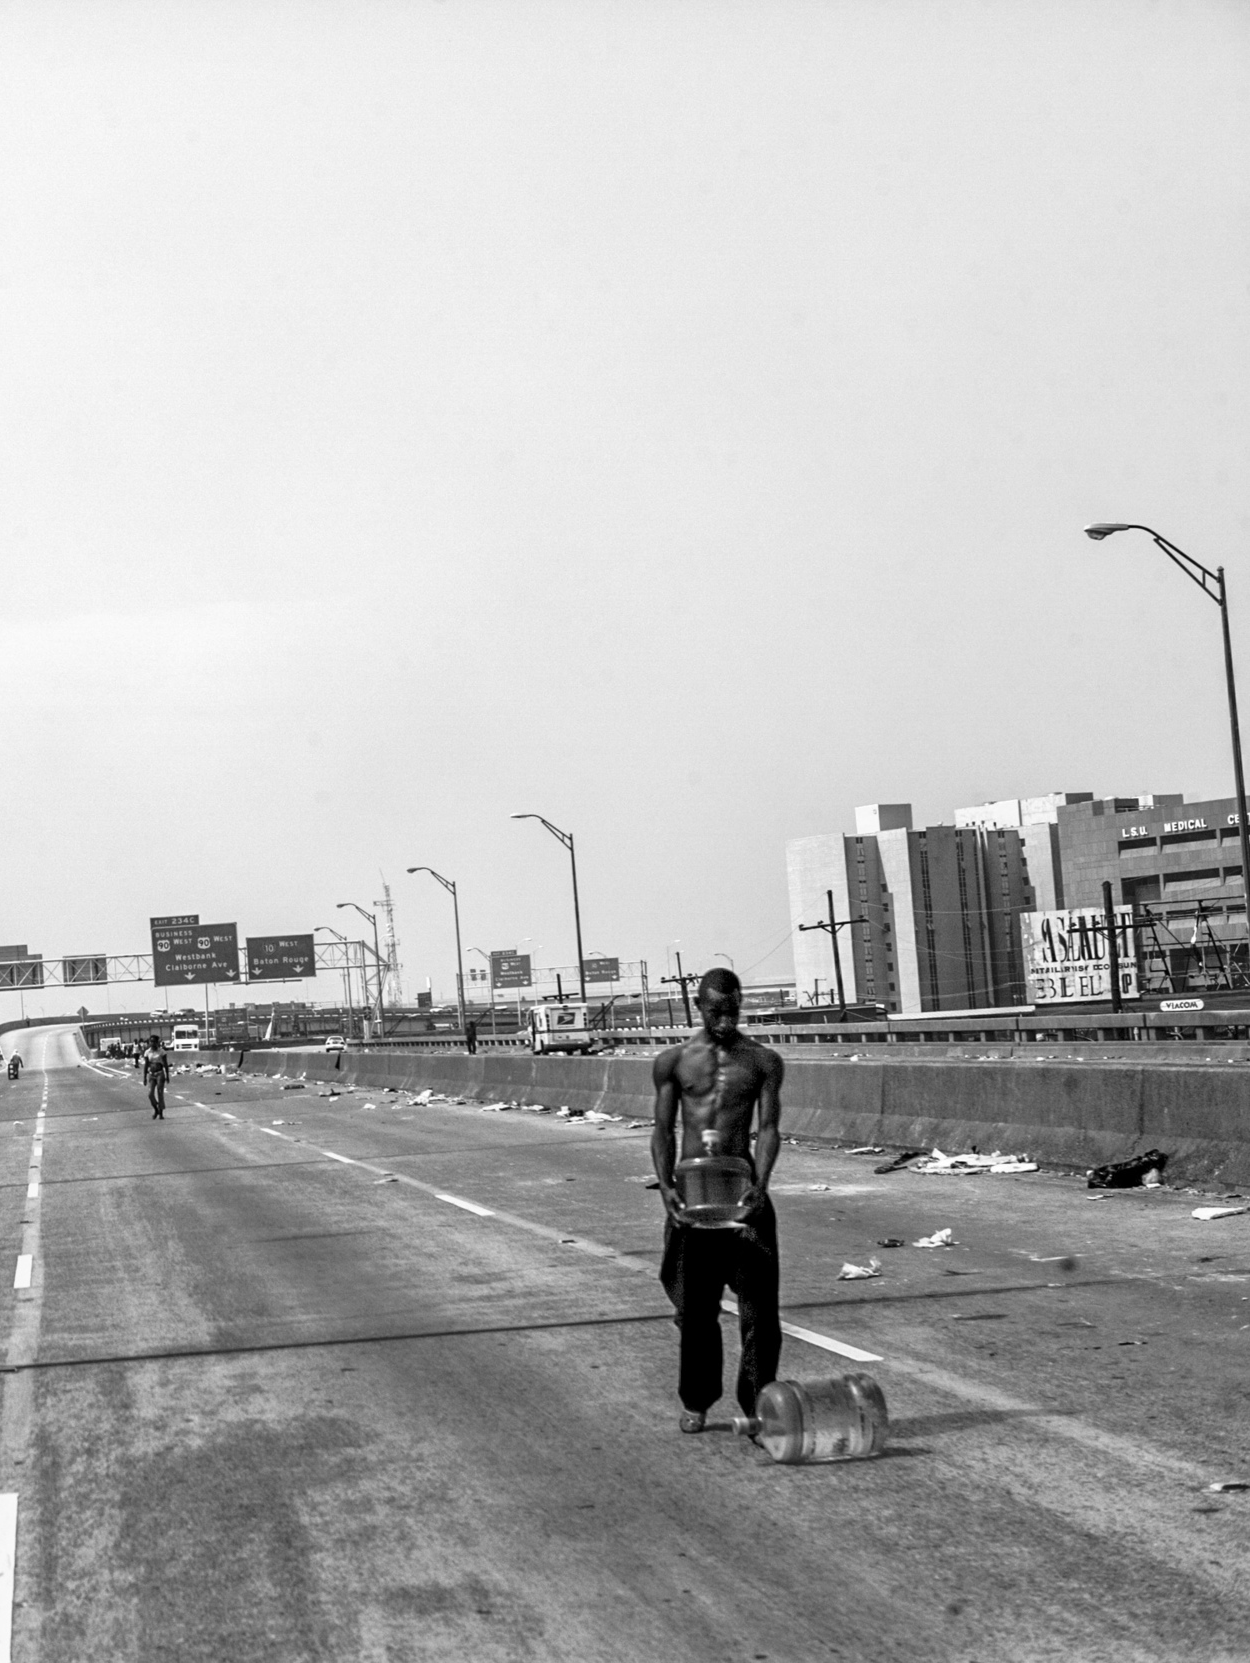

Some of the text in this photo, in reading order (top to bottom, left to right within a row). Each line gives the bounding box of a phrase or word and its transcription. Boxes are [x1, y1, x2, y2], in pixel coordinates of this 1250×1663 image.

[1163, 818, 1207, 832] MEDICAL
[171, 917, 195, 925] 234C
[155, 930, 193, 938] BUSINESS
[198, 939, 210, 947] 90
[265, 944, 274, 952] 10
[175, 952, 217, 961] Westbank
[282, 956, 309, 964] Rouge
[165, 963, 207, 971] Claiborne
[1166, 1001, 1198, 1009] VIACOM
